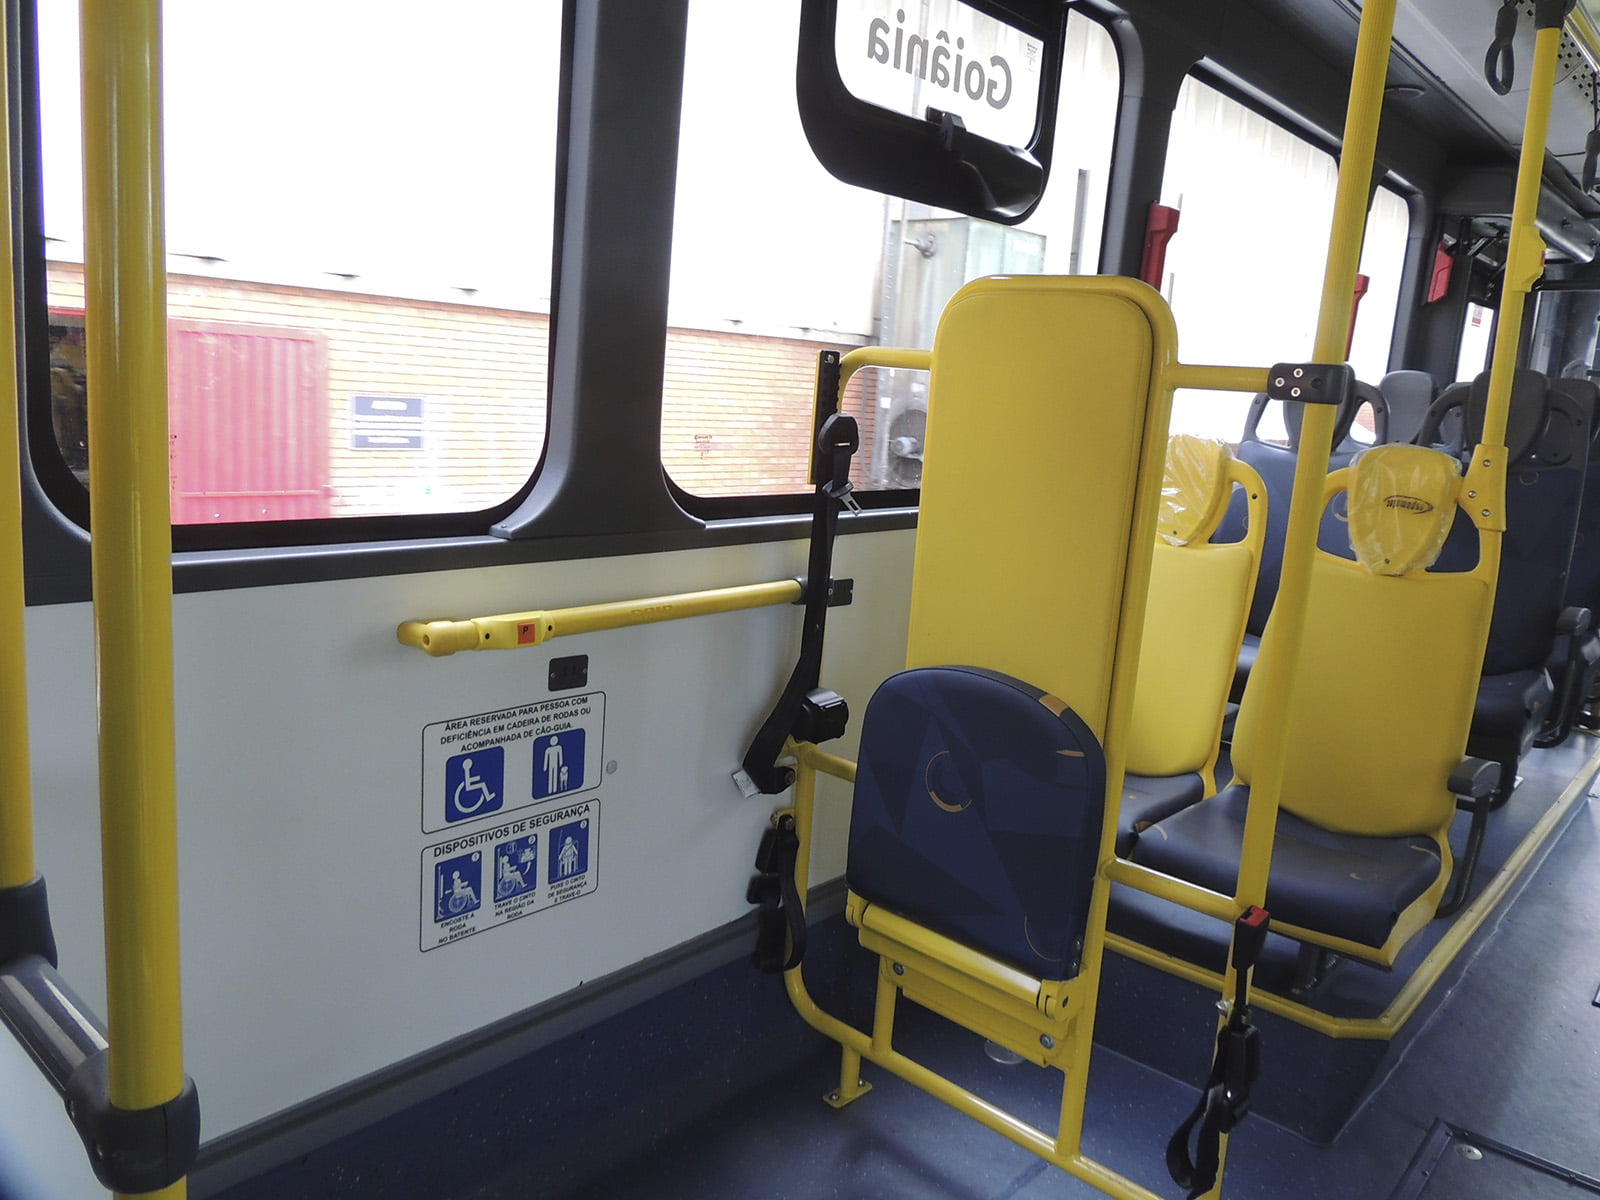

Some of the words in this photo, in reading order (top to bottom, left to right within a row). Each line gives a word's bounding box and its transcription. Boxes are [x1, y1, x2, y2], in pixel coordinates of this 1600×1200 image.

[523, 626, 528, 635] P
[445, 719, 467, 731] ÁREA
[470, 711, 517, 726] RESERVADA
[519, 706, 538, 716] PARA
[540, 701, 570, 713] PESSOA
[572, 697, 588, 706] COM
[440, 727, 491, 745] DEFICIÊNCIA
[493, 724, 505, 733] EM
[507, 717, 539, 730] CADEIRA
[541, 714, 551, 723] DE
[554, 709, 579, 720] RODAS
[581, 707, 591, 715] OU
[461, 733, 522, 752] ACOMPANHADA
[523, 730, 533, 739] DE
[434, 830, 509, 857] DISPOSITIVOS
[513, 823, 526, 834] DE
[529, 804, 590, 829] SEGURANÇA
[556, 881, 587, 897] SEGURANÇA
[495, 900, 512, 910] TRAVE
[519, 892, 536, 902] CINTO
[495, 909, 503, 917] NA
[505, 903, 525, 914] REGIÃO
[507, 911, 523, 920] RODA
[441, 915, 469, 928] ENCOSTE
[449, 922, 466, 933] RODA
[449, 927, 476, 940] BATENTE
